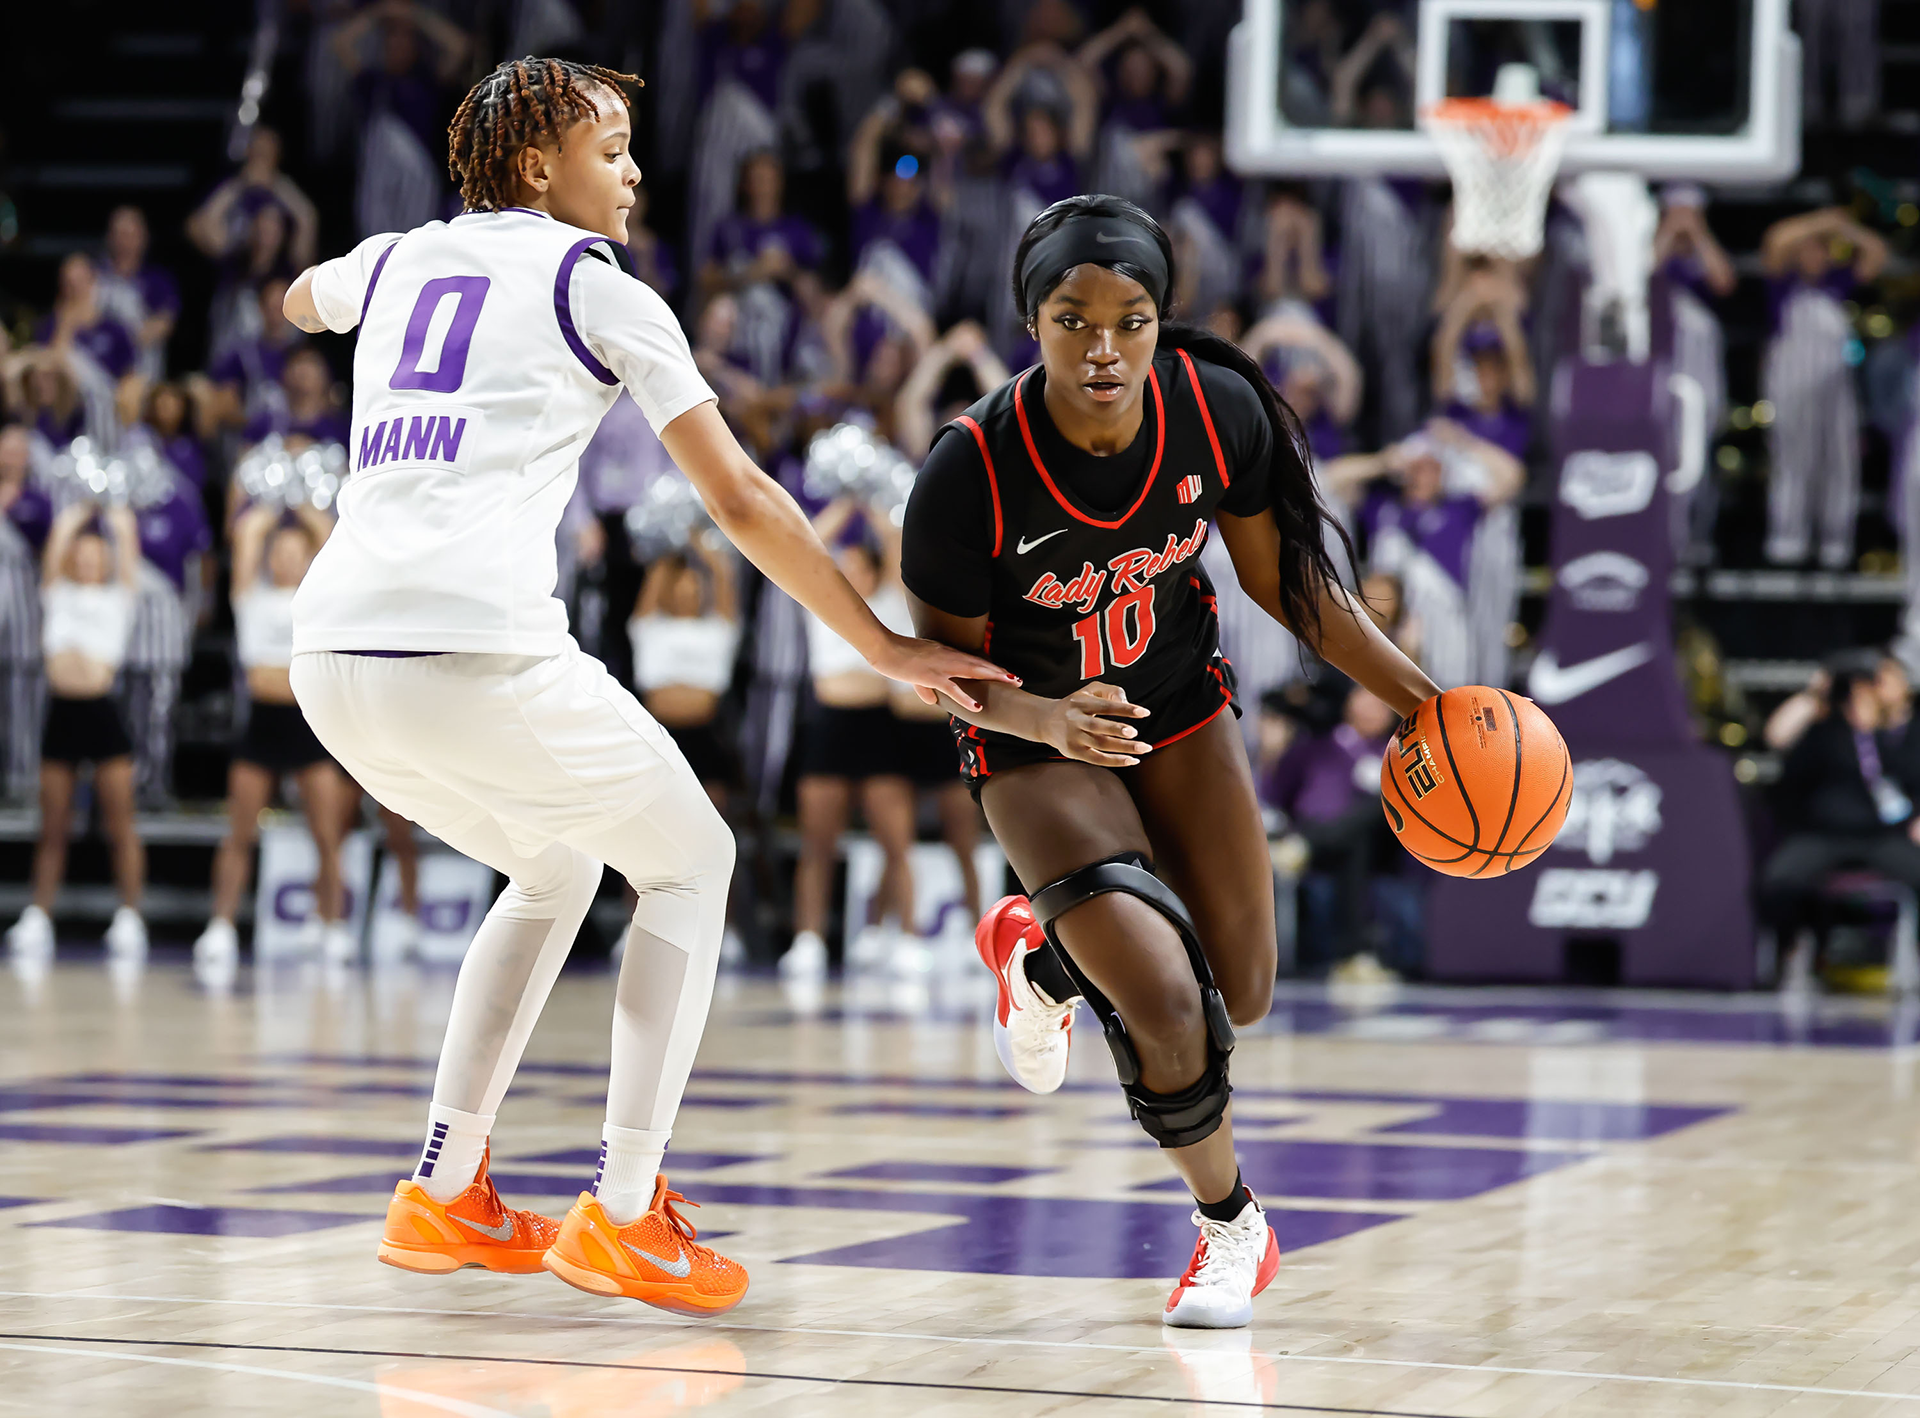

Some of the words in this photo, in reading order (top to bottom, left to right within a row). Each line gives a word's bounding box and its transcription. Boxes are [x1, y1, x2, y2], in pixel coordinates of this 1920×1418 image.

[389, 275, 491, 393] 0
[357, 415, 467, 473] MANN
[1022, 561, 1107, 614] Lady
[1071, 584, 1156, 680] 10
